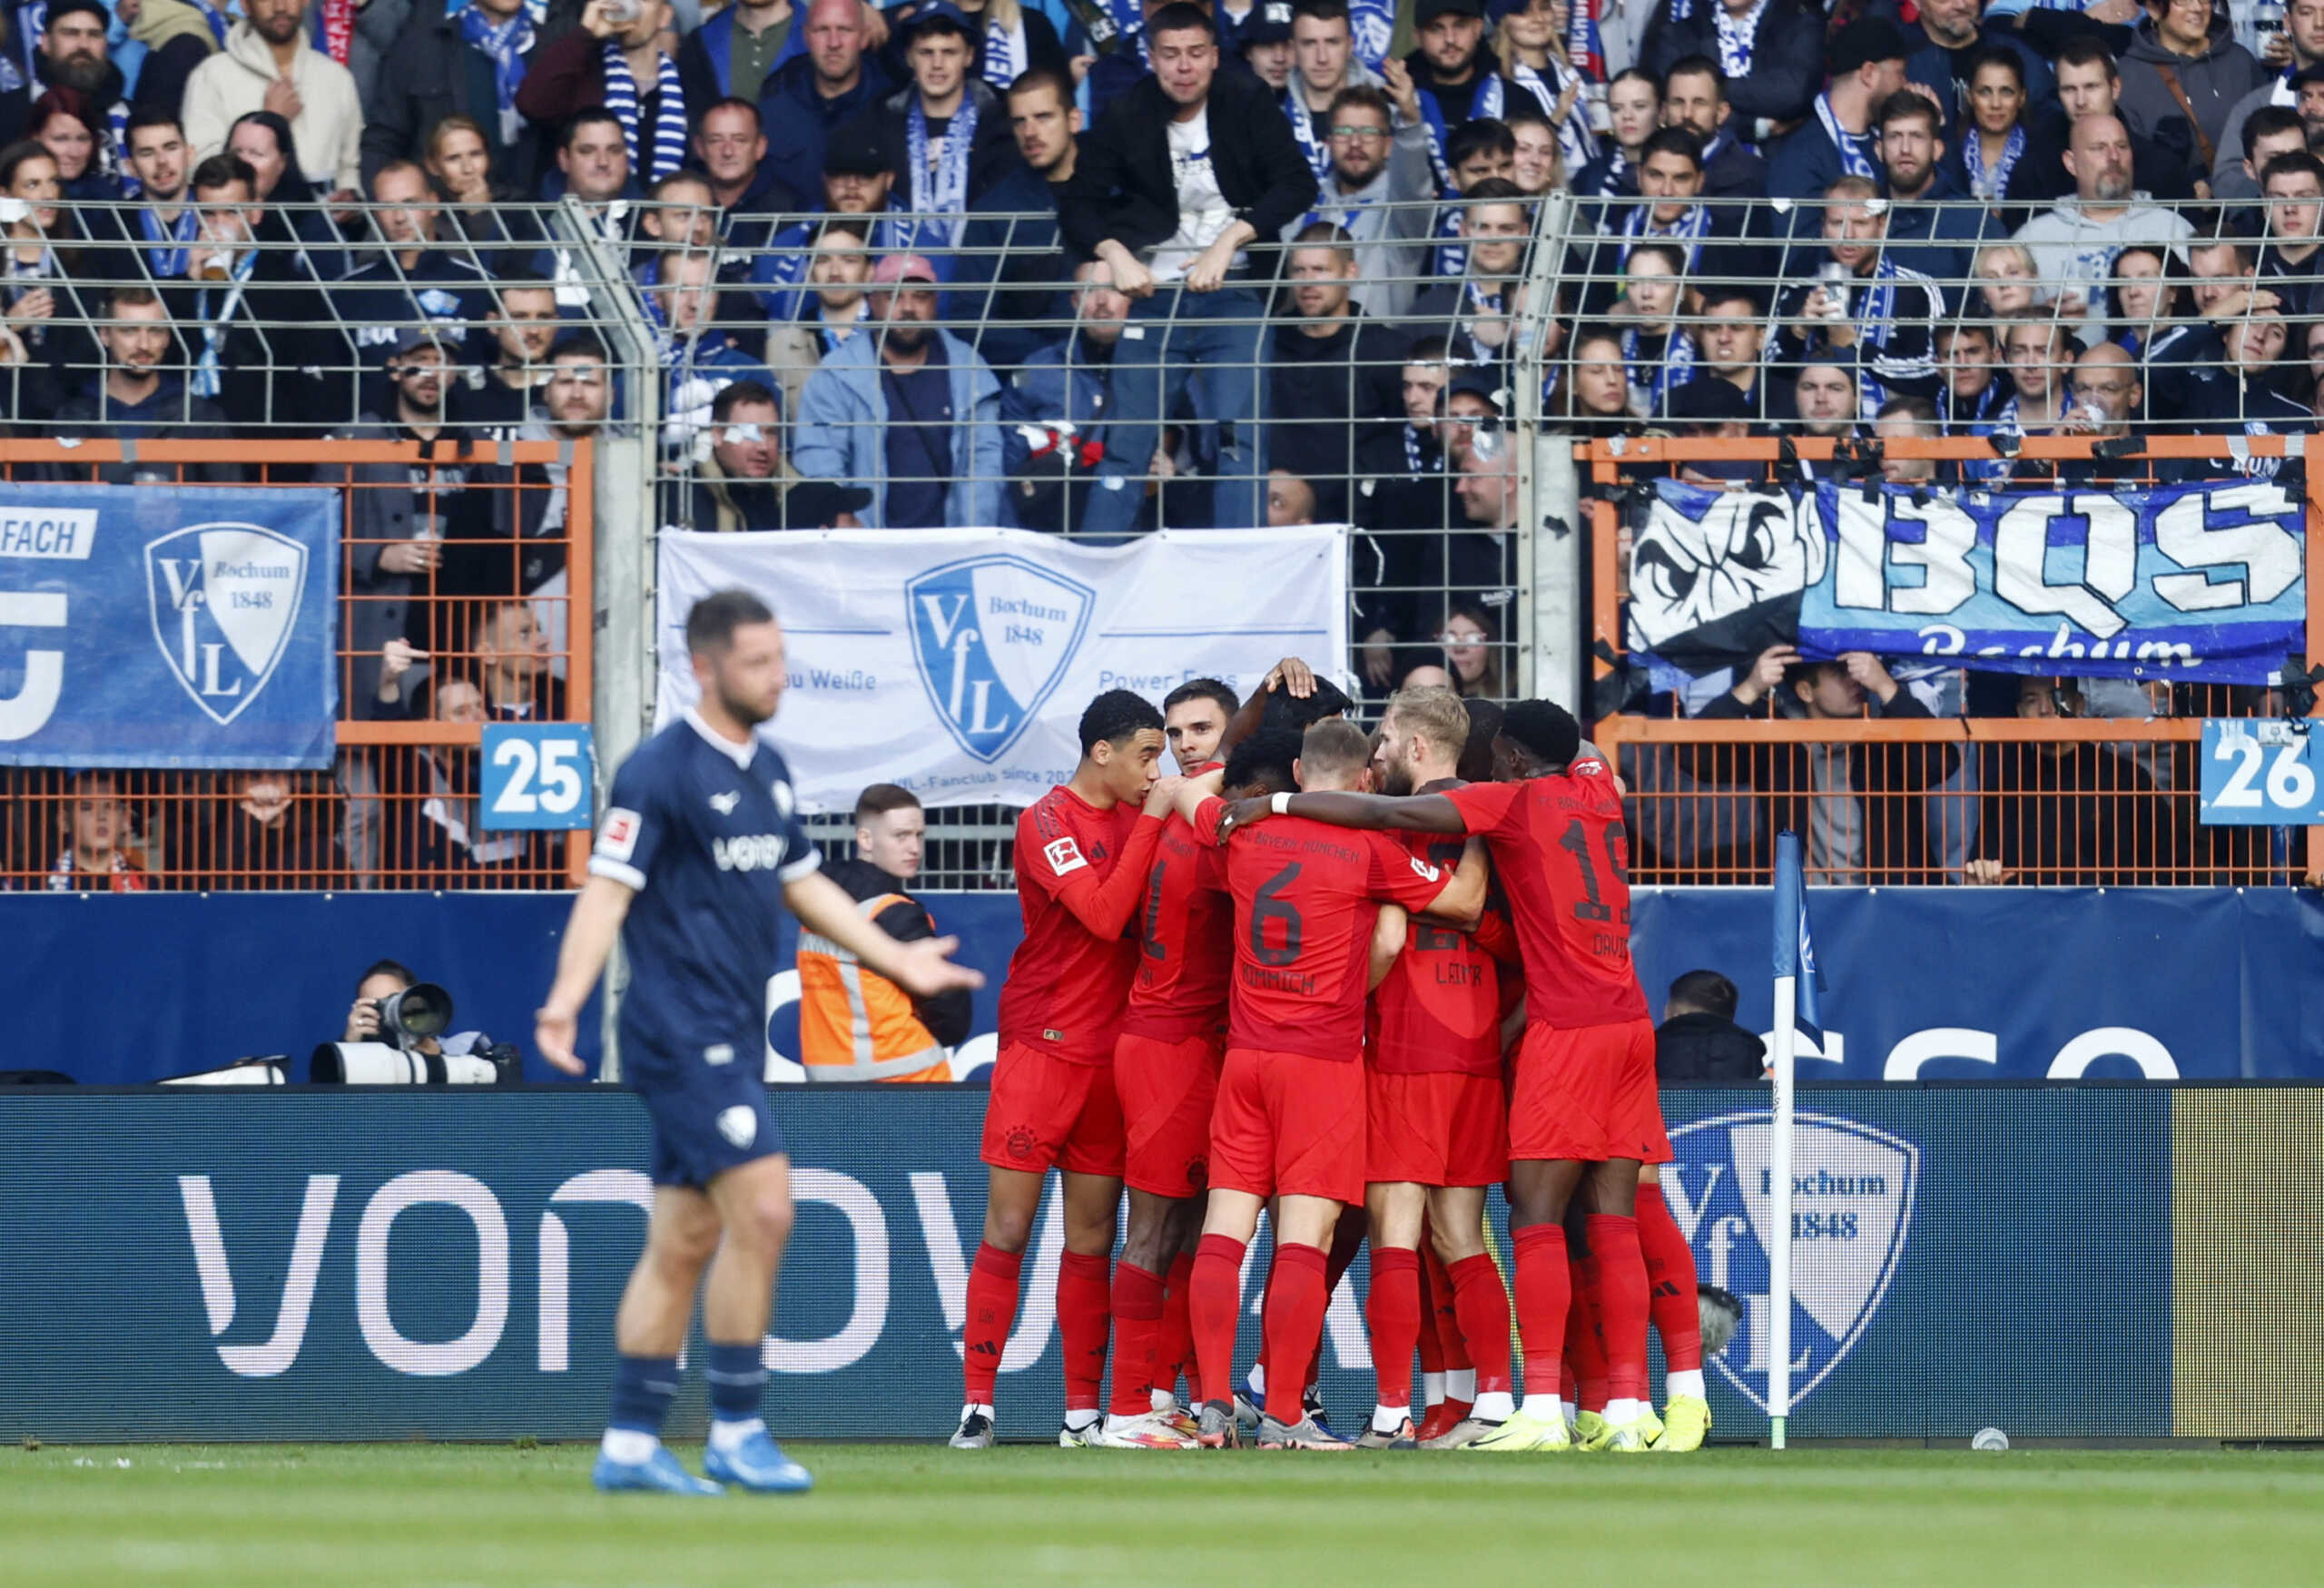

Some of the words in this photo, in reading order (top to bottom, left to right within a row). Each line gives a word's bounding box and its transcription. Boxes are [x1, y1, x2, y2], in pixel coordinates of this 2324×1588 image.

[213, 561, 290, 581] Bochum
[1834, 482, 2303, 639] BQS
[231, 591, 273, 610] 1848
[990, 597, 1068, 622] Bochum
[1004, 625, 1045, 646] 1848
[810, 670, 878, 691] Weiße
[1099, 669, 1175, 689] Power
[492, 737, 583, 814] 25
[1001, 767, 1040, 784] since
[2211, 734, 2316, 809] 26
[1251, 861, 1303, 967] 6
